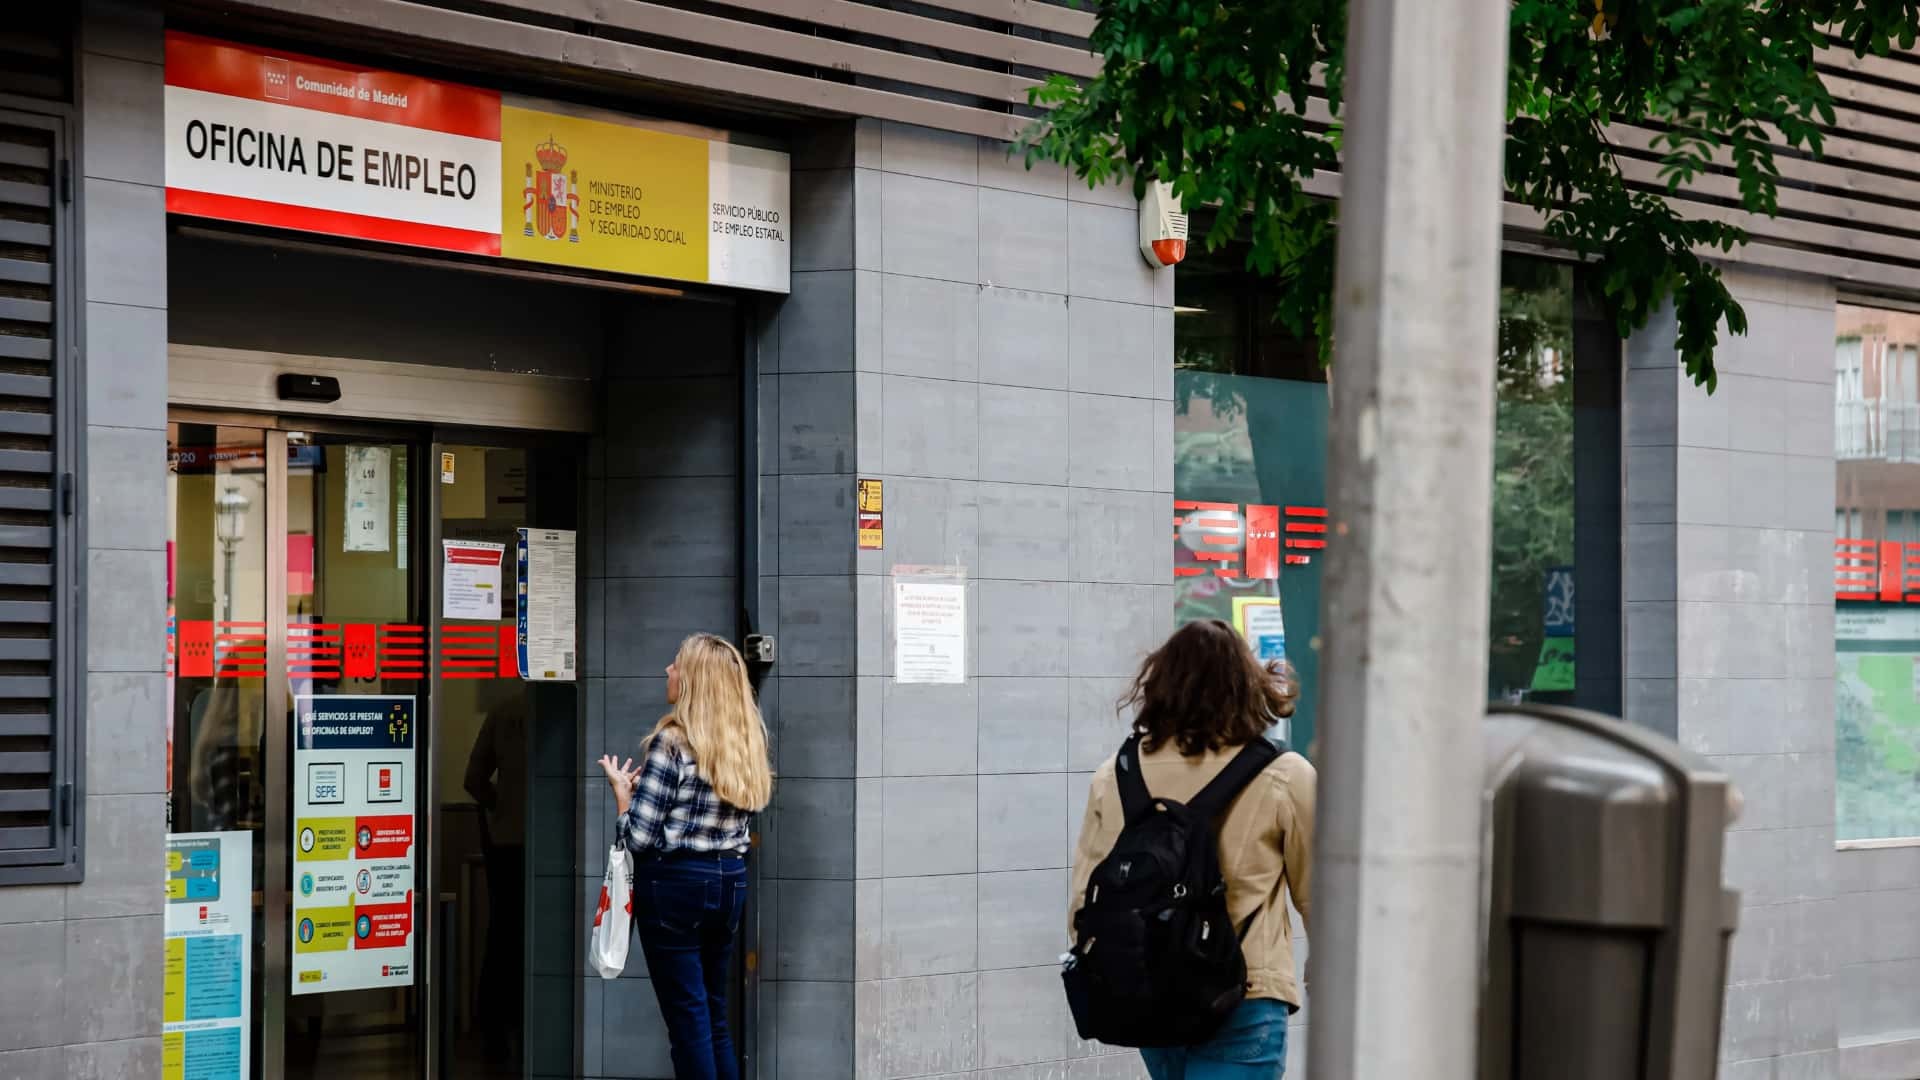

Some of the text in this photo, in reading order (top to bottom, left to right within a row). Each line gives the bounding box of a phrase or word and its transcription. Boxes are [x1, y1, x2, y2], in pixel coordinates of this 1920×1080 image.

[296, 75, 408, 109] Comunidad de Madrid
[186, 119, 477, 201] OFICINA DE EMPLEO
[589, 180, 643, 201] MINISTERIO
[589, 200, 641, 220] DE EMPLEO
[712, 202, 780, 223] SERVICIO PÚBLICO
[589, 219, 687, 246] Y SEGURIDAD SOCIAL
[712, 220, 785, 242] DE EMPLEO ESTATAL
[318, 712, 348, 721] SERVICIOS
[349, 712, 357, 721] SE
[357, 711, 383, 721] PRESTAN
[312, 726, 339, 735] OFICINAS
[339, 727, 348, 735] DE
[315, 785, 337, 798] SEPE
